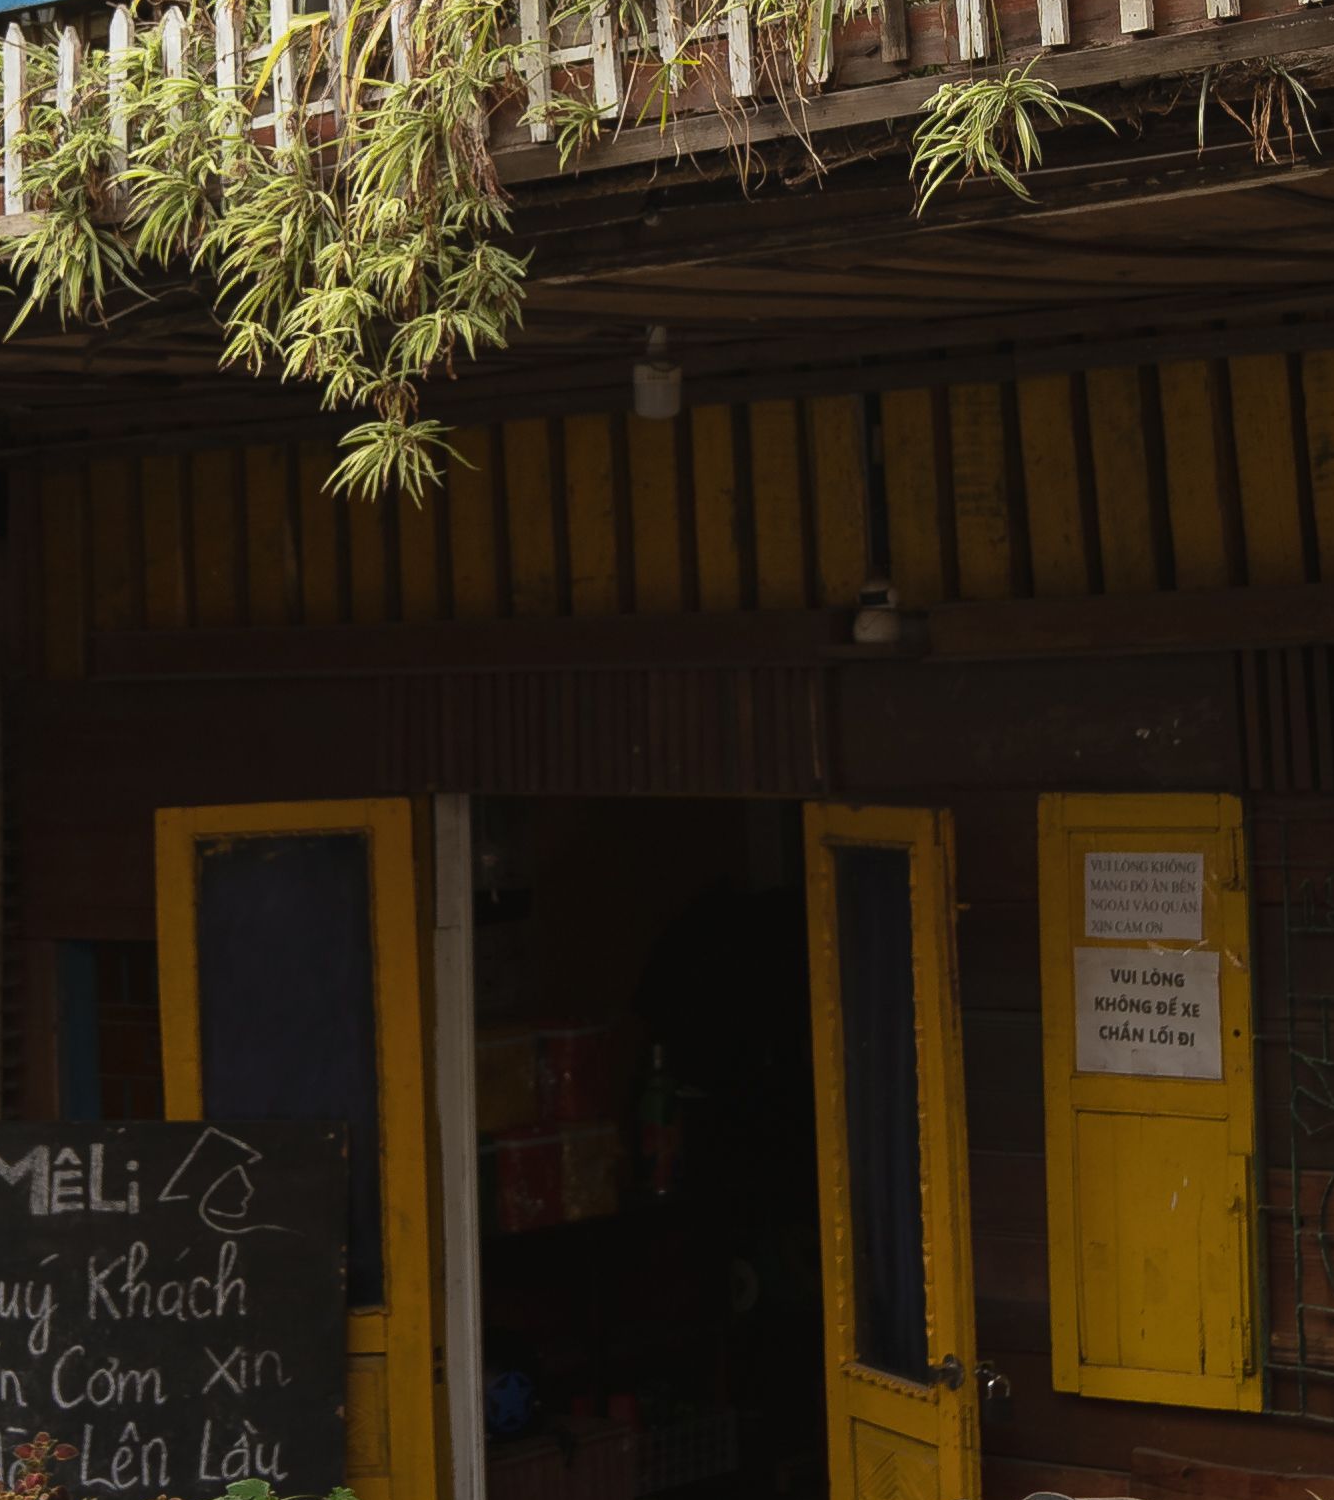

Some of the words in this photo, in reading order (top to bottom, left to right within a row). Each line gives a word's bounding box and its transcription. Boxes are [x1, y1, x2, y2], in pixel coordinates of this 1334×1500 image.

[1090, 859, 1111, 873] VUI
[1090, 879, 1127, 892] MANG
[1110, 968, 1137, 983] VUI
[1142, 967, 1185, 988] LÒNG
[1094, 994, 1152, 1014] KHÔNG
[1181, 1002, 1201, 1018] XE
[1149, 1025, 1174, 1045] LỐI
[1178, 1031, 1195, 1047] ĐI
[88, 1240, 247, 1322] Khách
[202, 1345, 293, 1395] Xin
[80, 1421, 170, 1490] Lên
[198, 1419, 288, 1482] Lầu
